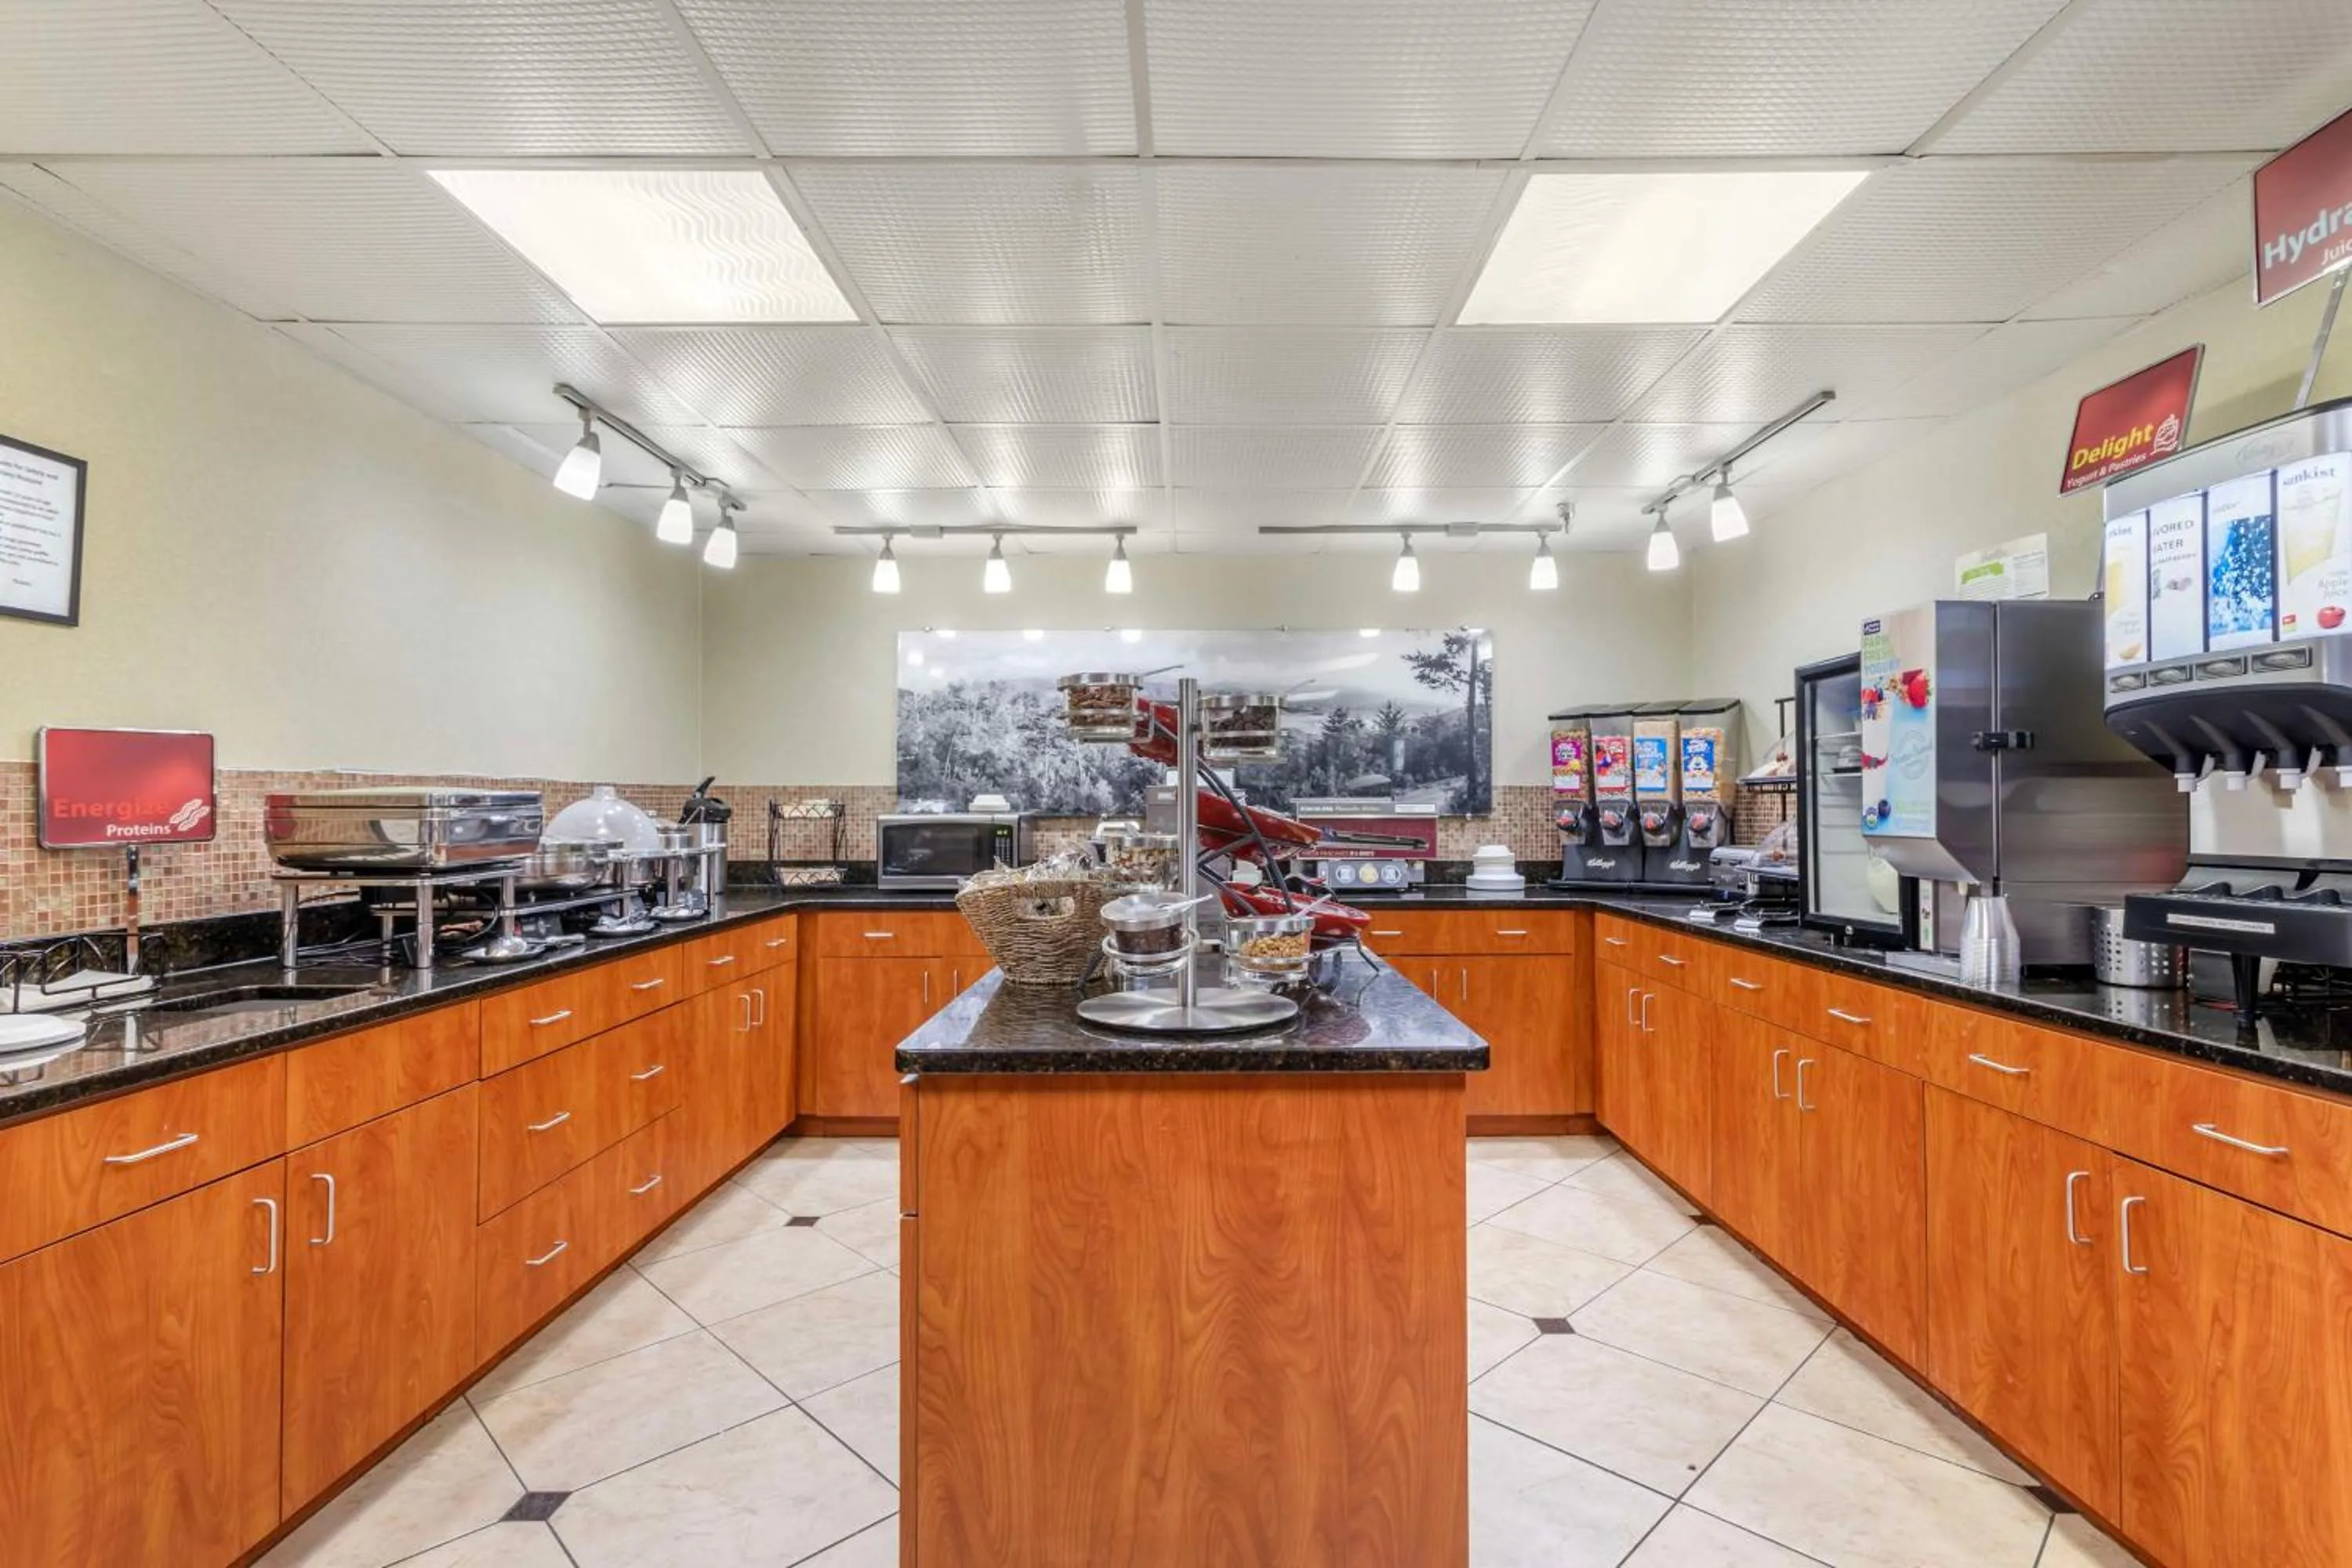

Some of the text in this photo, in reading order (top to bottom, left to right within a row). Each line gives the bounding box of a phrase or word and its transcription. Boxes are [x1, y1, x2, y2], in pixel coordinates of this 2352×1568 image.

[2071, 423, 2154, 470] Delight
[2067, 452, 2147, 488] Yogurt & Pastries
[53, 798, 169, 821] Energize
[106, 822, 172, 837] Proteins
